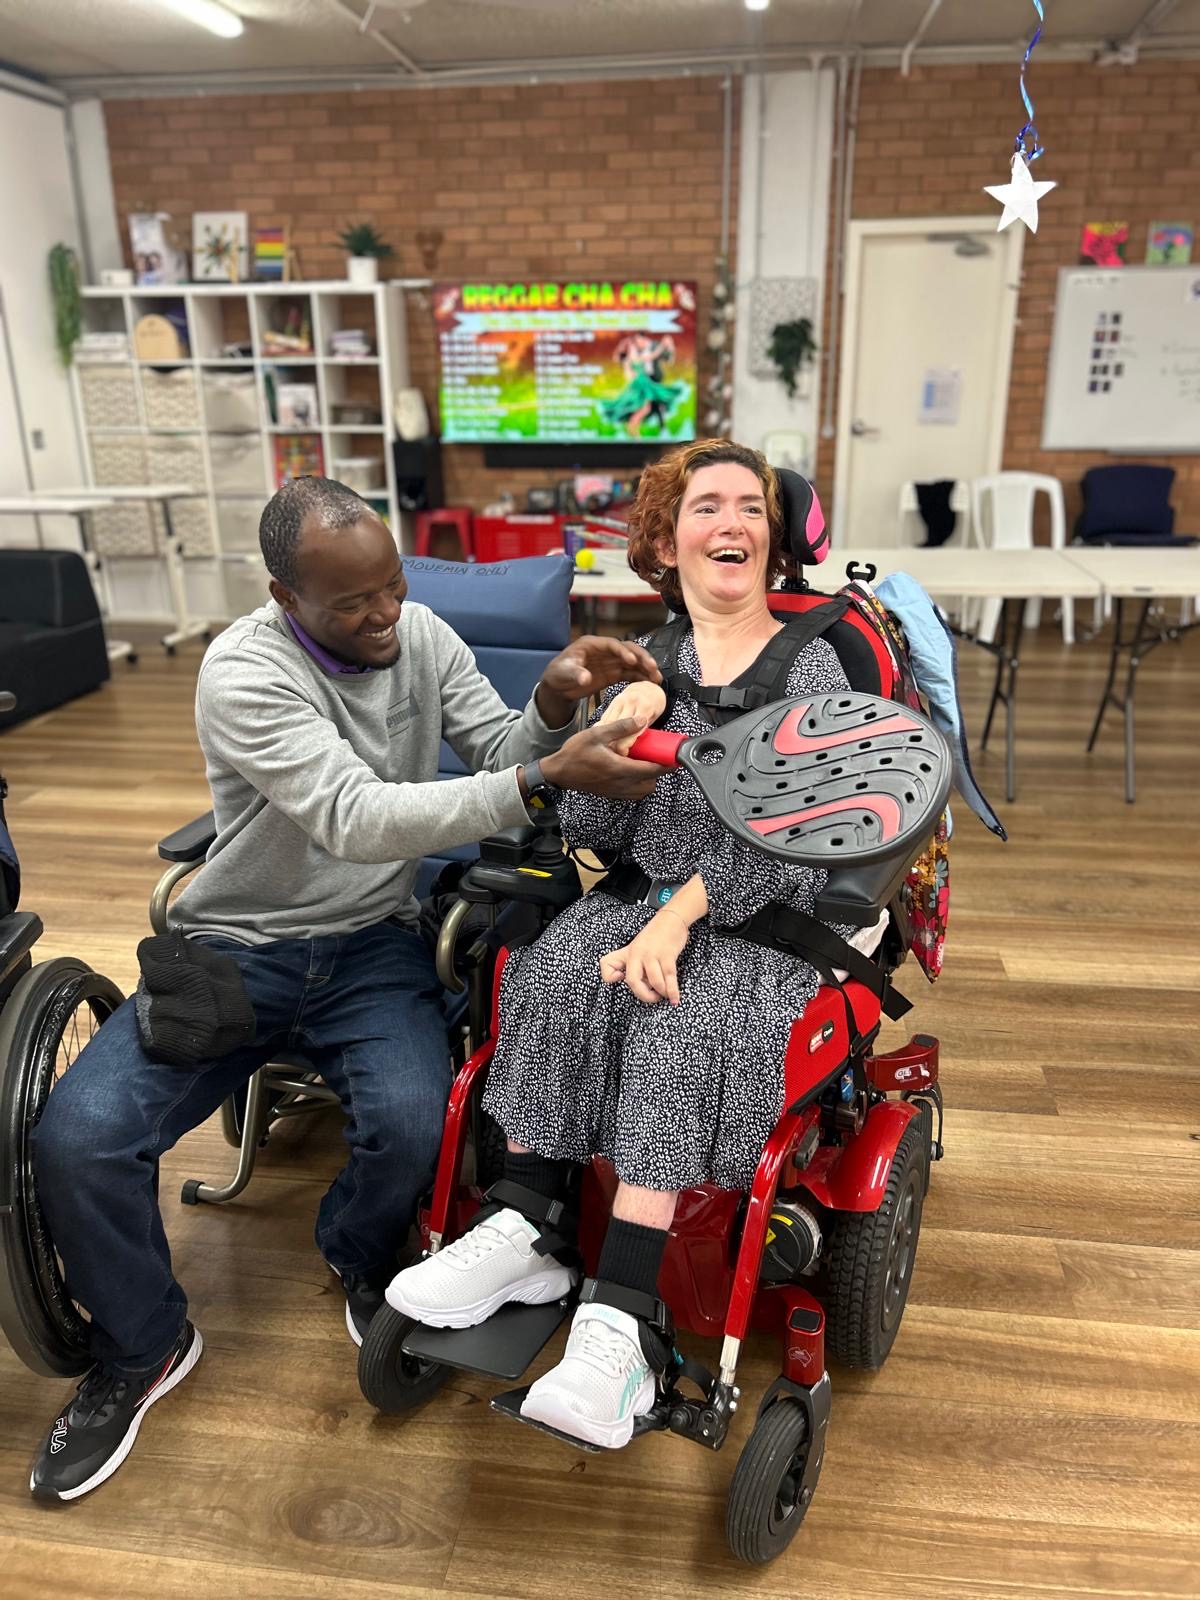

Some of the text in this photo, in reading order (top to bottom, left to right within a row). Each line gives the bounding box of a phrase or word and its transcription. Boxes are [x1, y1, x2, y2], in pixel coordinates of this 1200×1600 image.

[563, 282, 615, 308] CHA
[620, 281, 673, 308] CHA
[475, 566, 511, 577] ONLY
[50, 1415, 68, 1454] FILA
